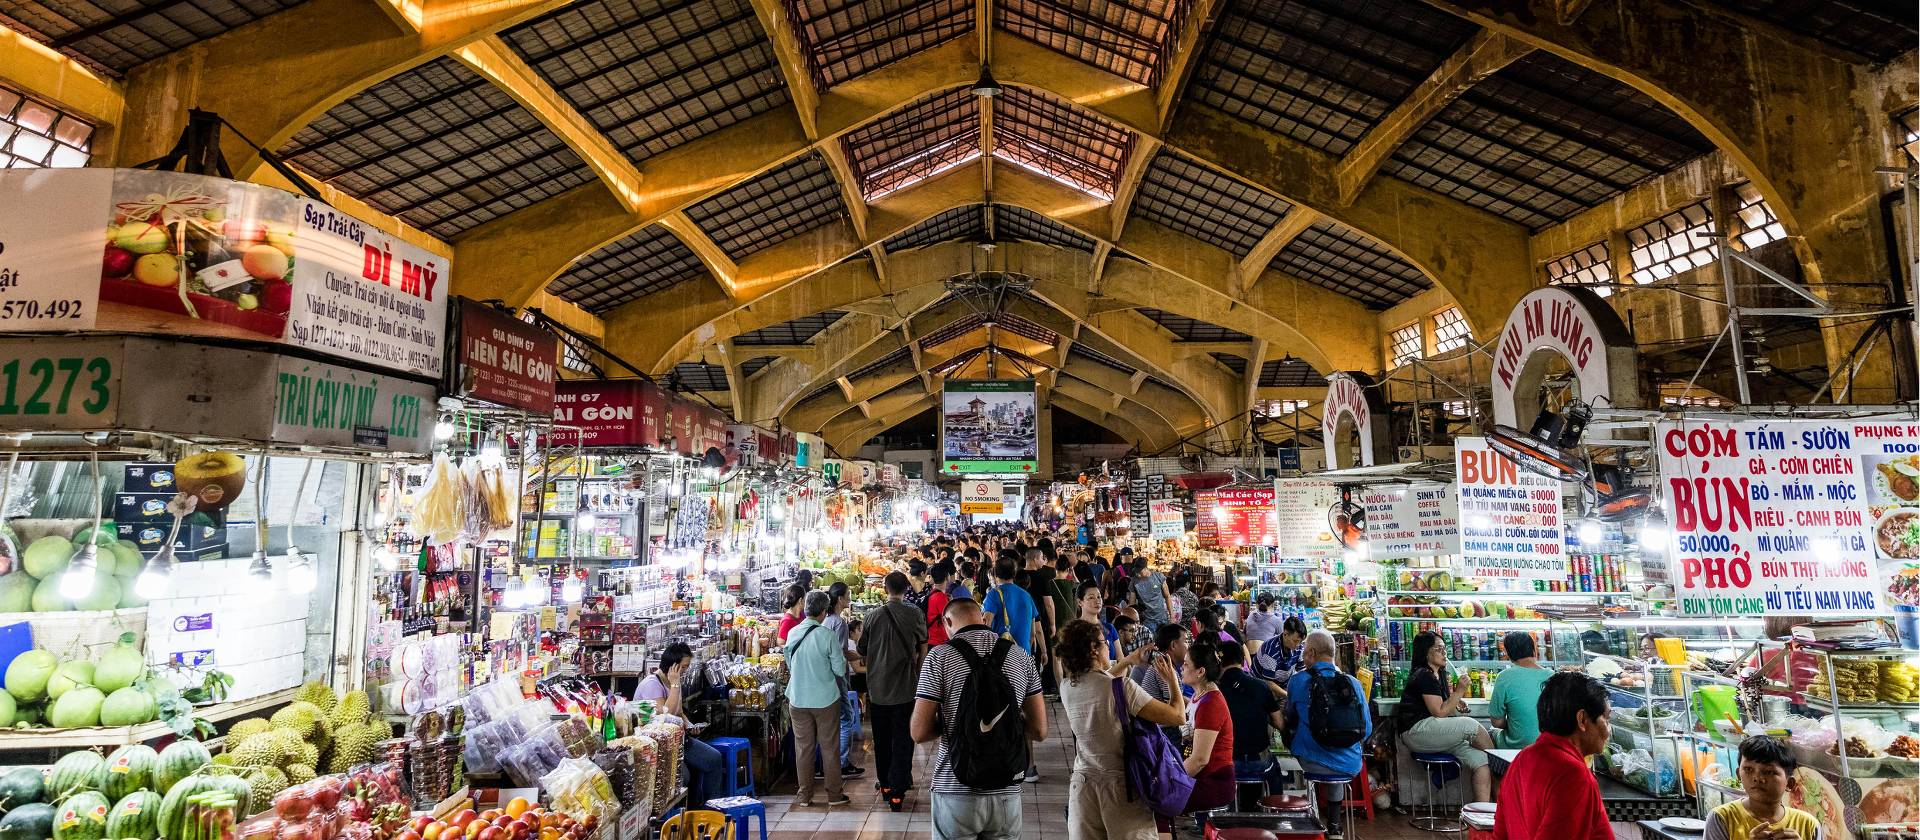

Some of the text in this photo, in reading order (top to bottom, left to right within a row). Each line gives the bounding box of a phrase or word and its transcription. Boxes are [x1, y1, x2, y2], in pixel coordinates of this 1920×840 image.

[305, 203, 365, 247] Sạp Trái Cây
[363, 243, 438, 302] DÌ MỸ
[493, 328, 506, 343] GIA
[1498, 299, 1593, 391] KHU ĂN UỐNG
[502, 347, 523, 375] SÀI
[527, 356, 552, 384] GÒN
[0, 356, 111, 415] 1273
[278, 366, 311, 427] TRÁI
[312, 369, 341, 429] CÂY
[340, 373, 356, 430] DÌ
[389, 393, 421, 438] 1271
[581, 393, 600, 402] G7
[581, 403, 633, 421] GÒN
[1665, 423, 1740, 458] CƠM
[1745, 424, 1850, 450] TẤM SƯỜN
[1854, 426, 1903, 440] PHỤNG
[1749, 454, 1854, 475] GÀ CƠM CHIÊN
[1417, 491, 1434, 500] SINH
[1462, 485, 1555, 501] MÌ QUẢNG MIẾN GÀ 50000
[1669, 461, 1752, 533] BÚN
[1751, 478, 1857, 503] BÒ MẮM MỘC
[1380, 504, 1393, 512] CAM
[1491, 502, 1508, 512] NAM
[1510, 503, 1530, 513] VANG
[1532, 503, 1557, 514] 50000
[1754, 507, 1862, 527] RIÊU CANH BÚN
[1491, 542, 1514, 553] CANH
[1516, 543, 1533, 553] CUA
[1535, 544, 1559, 555] 50000
[1680, 535, 1730, 552] 50.000
[1757, 529, 1866, 554] MÌ QUẢNG GÀ
[1475, 568, 1500, 577] CANH
[1680, 543, 1752, 588] PHỞ
[1761, 557, 1788, 578] BÚN
[1791, 561, 1819, 581] THỊT
[1683, 594, 1765, 614] BÚN TÔM CÀNG
[1766, 583, 1875, 610] HỦ TIẾU NAM VANG
